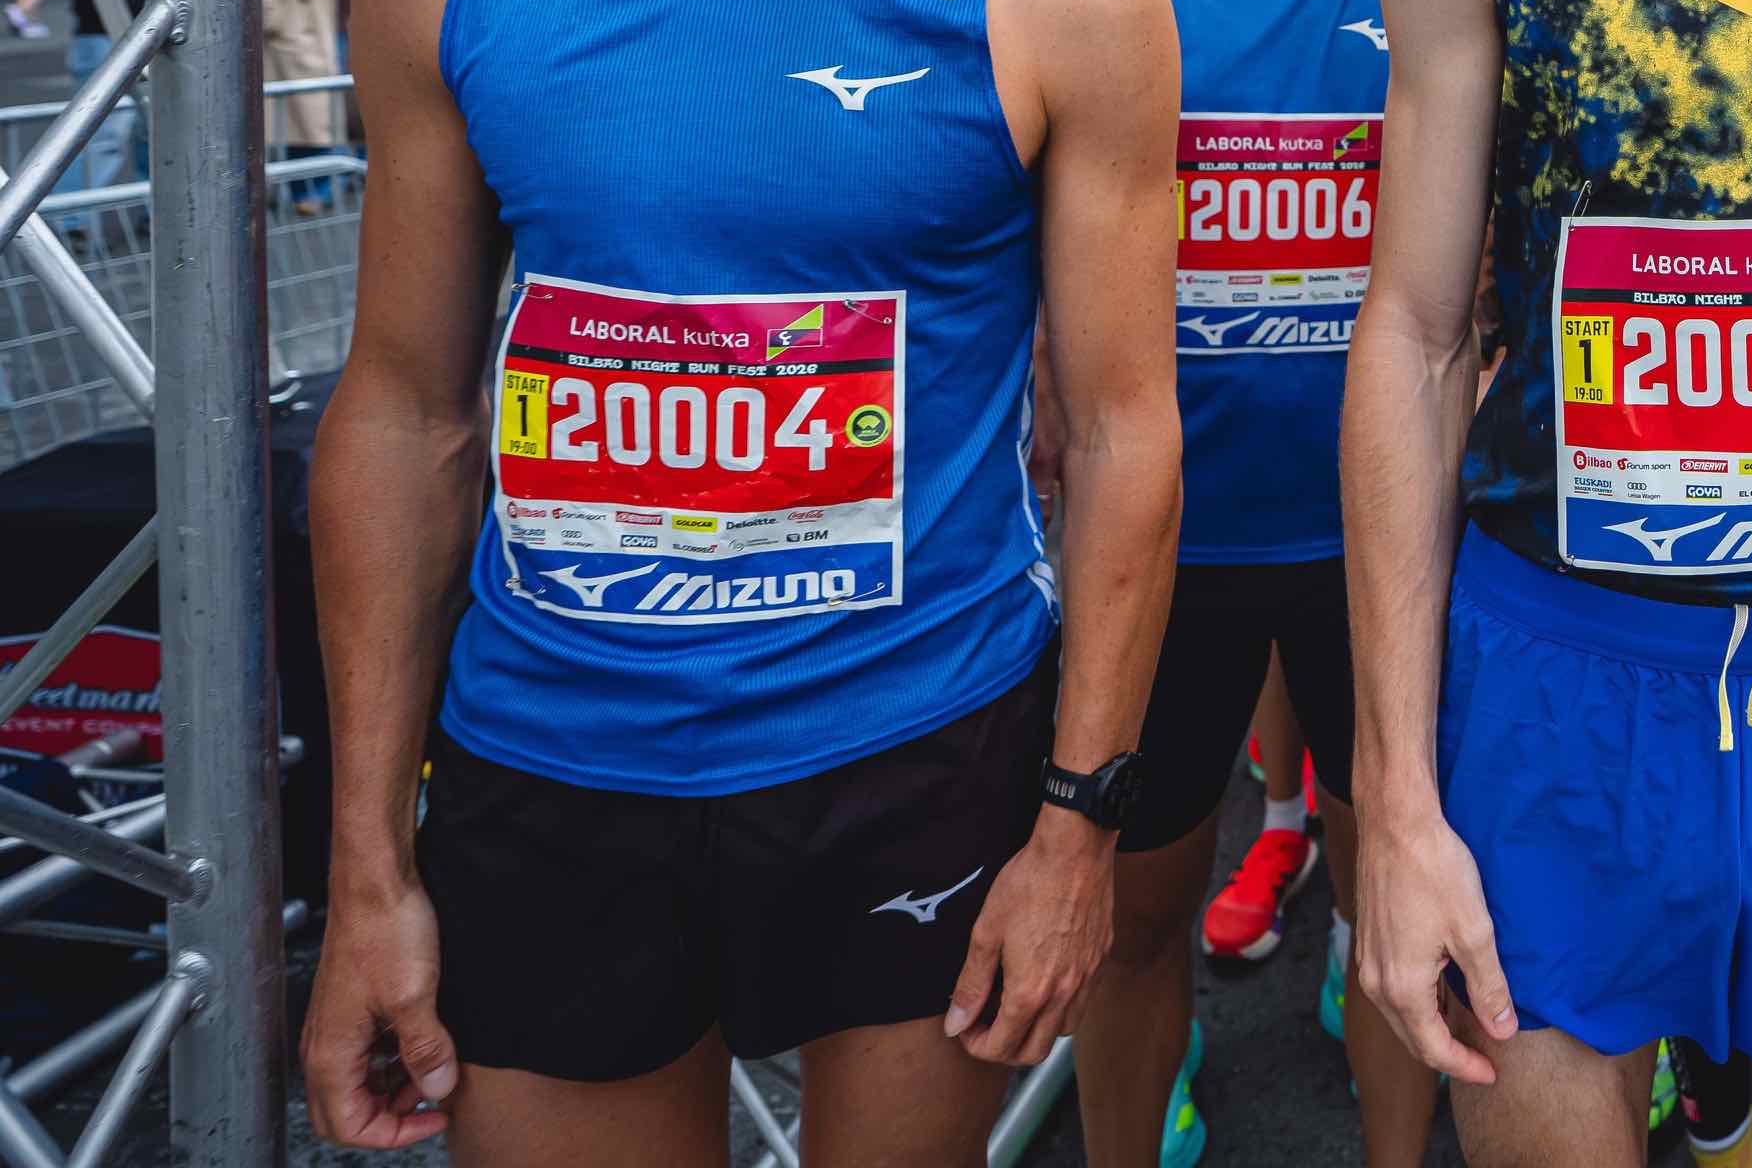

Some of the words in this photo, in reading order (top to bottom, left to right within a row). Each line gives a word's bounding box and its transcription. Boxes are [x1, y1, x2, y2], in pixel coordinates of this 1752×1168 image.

[1196, 137, 1275, 151] LABORAL
[1279, 137, 1323, 151] kutxa
[1190, 178, 1371, 241] 20006
[1631, 253, 1738, 275] LABORAL
[1634, 292, 1686, 305] BILBAO
[1695, 294, 1743, 305] NIGHT
[570, 316, 677, 344] LABORAL
[683, 328, 750, 349] kutxa
[1246, 317, 1356, 344] MIZU
[1565, 320, 1609, 336] START
[568, 354, 623, 369] BILBAO
[632, 360, 680, 373] NIGHT
[688, 363, 719, 374] RUN
[728, 364, 767, 376] FEST
[776, 364, 818, 376] 2026
[1579, 339, 1593, 383] 1
[505, 375, 545, 393] START
[1574, 387, 1604, 401] 19:00
[517, 395, 528, 436] 1
[551, 377, 833, 471] 20004
[1573, 450, 1612, 470] Bilbao
[1574, 477, 1612, 488] EUSKADI
[1688, 487, 1720, 496] GOYA
[804, 530, 828, 541] BM
